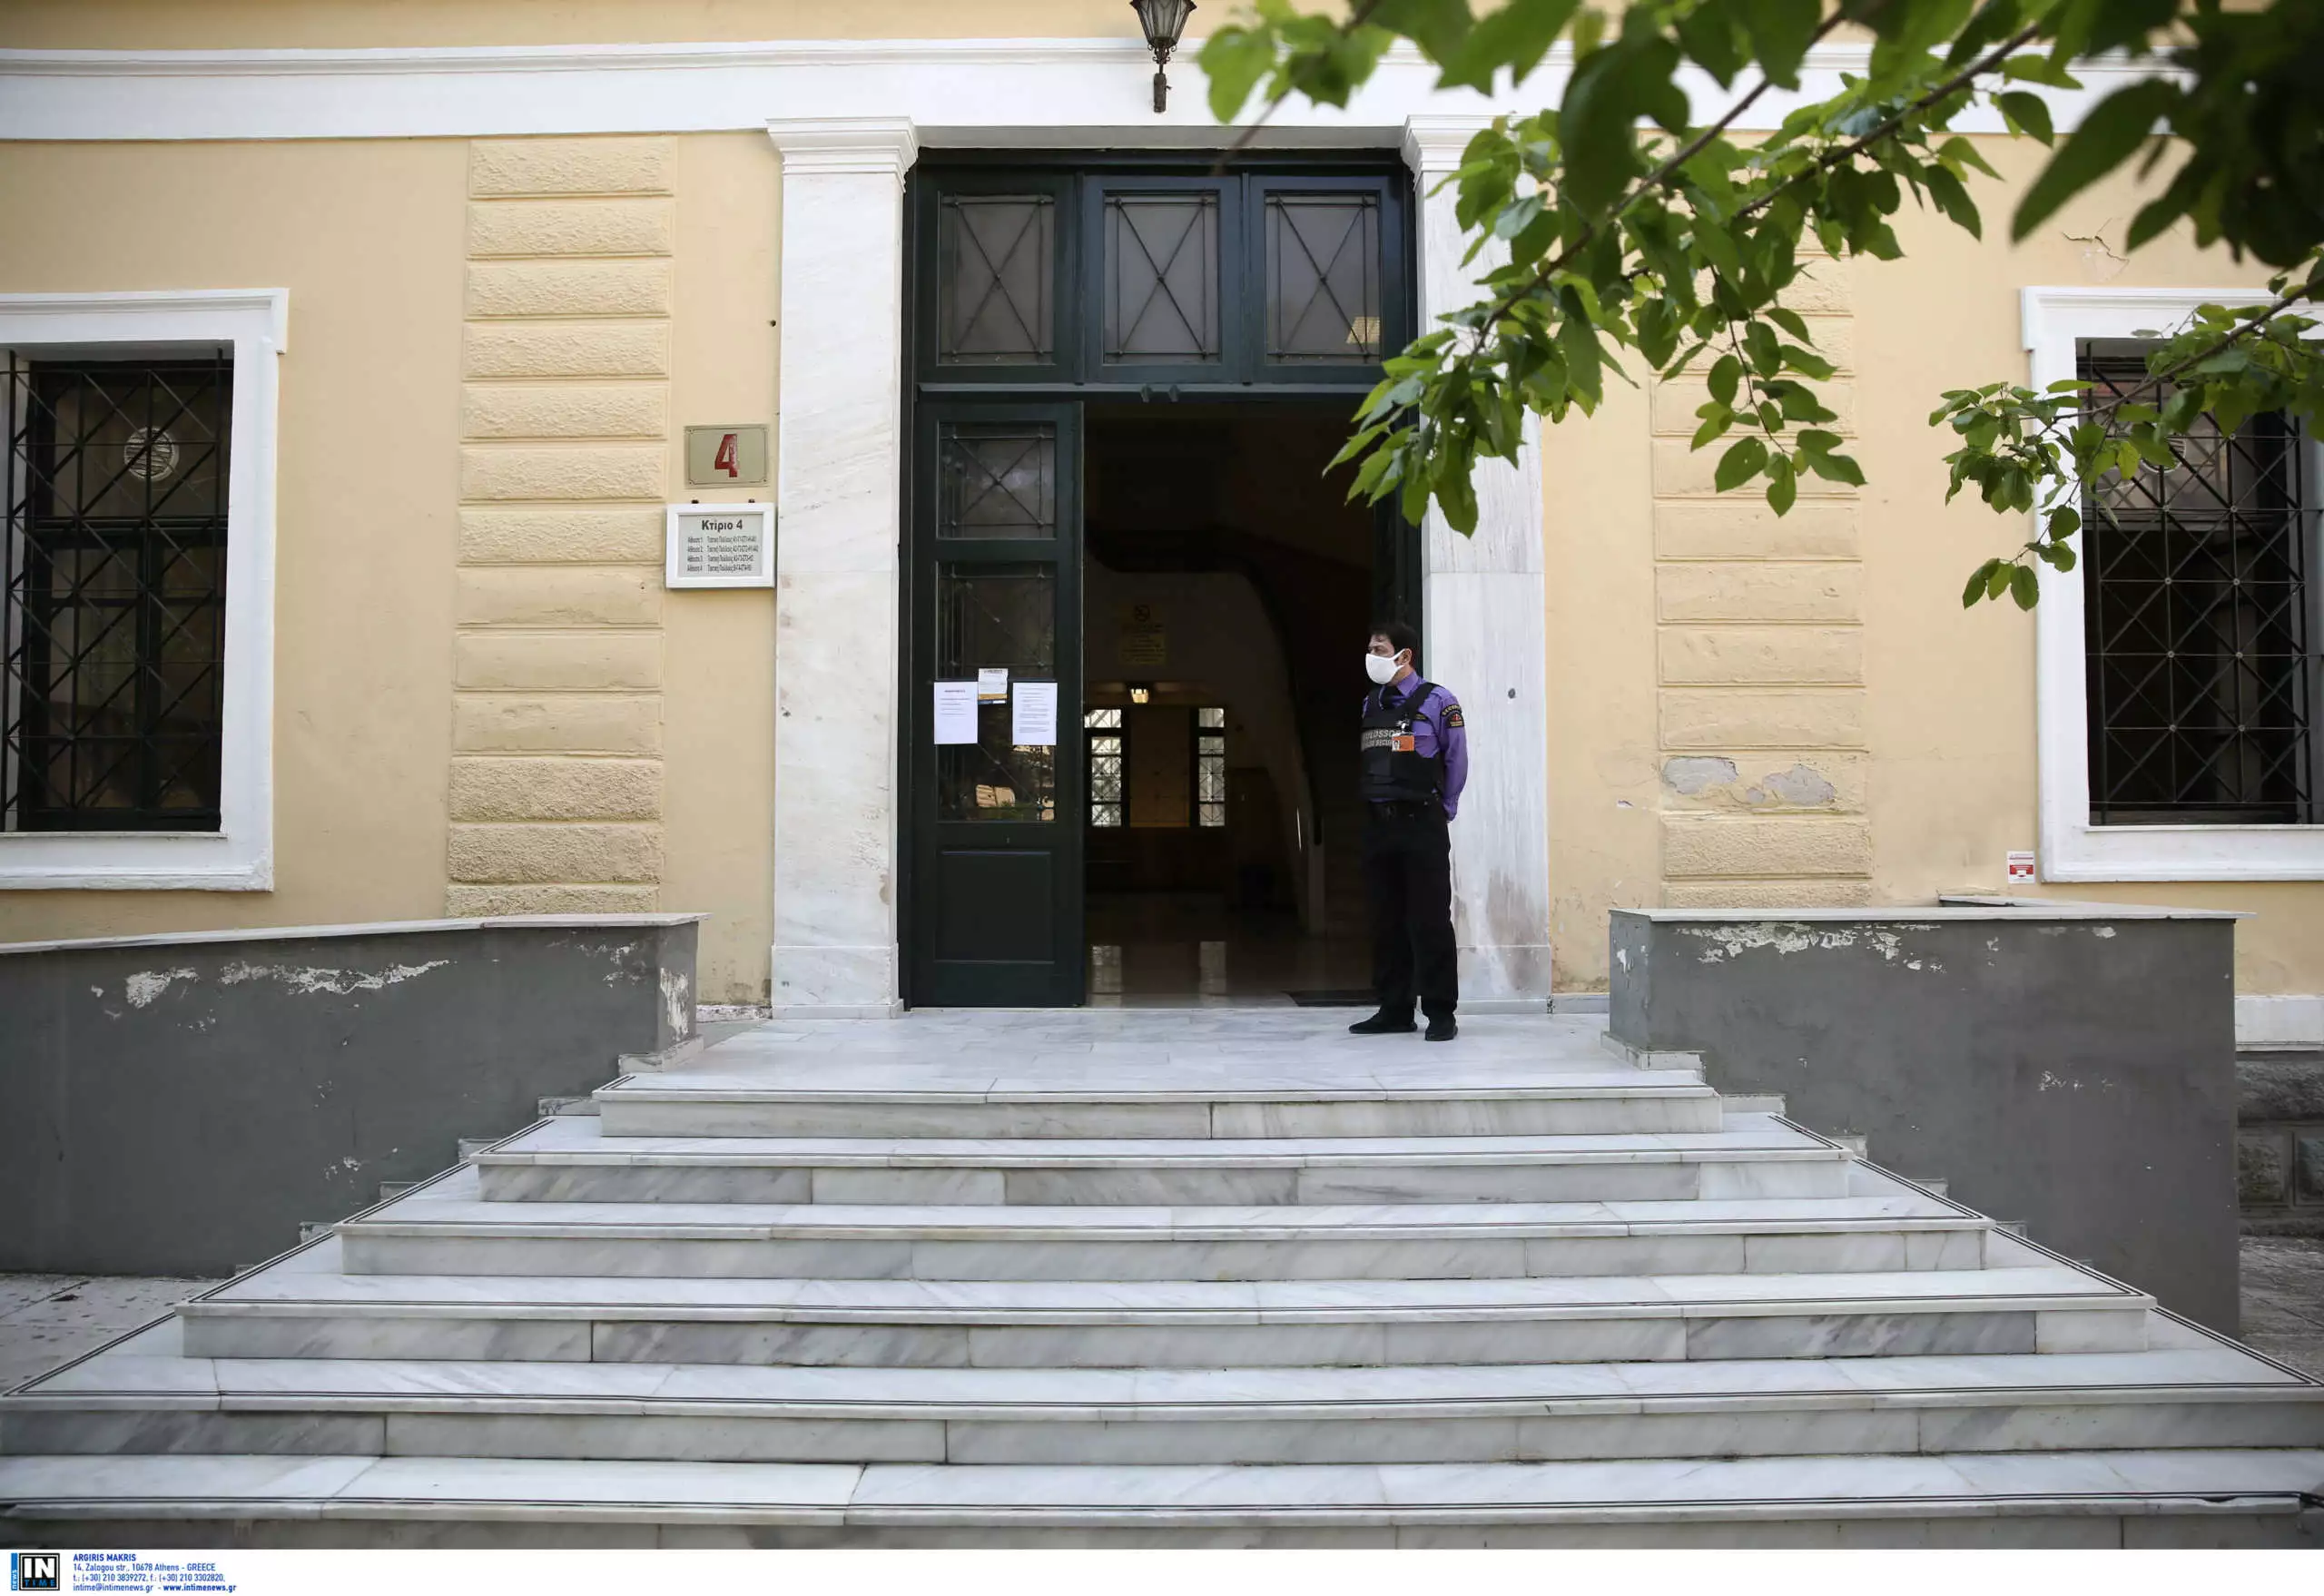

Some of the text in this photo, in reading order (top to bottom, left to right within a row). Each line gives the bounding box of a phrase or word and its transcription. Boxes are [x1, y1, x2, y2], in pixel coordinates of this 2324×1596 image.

[714, 434, 738, 478] 4
[702, 519, 743, 532] Κτίριο 4
